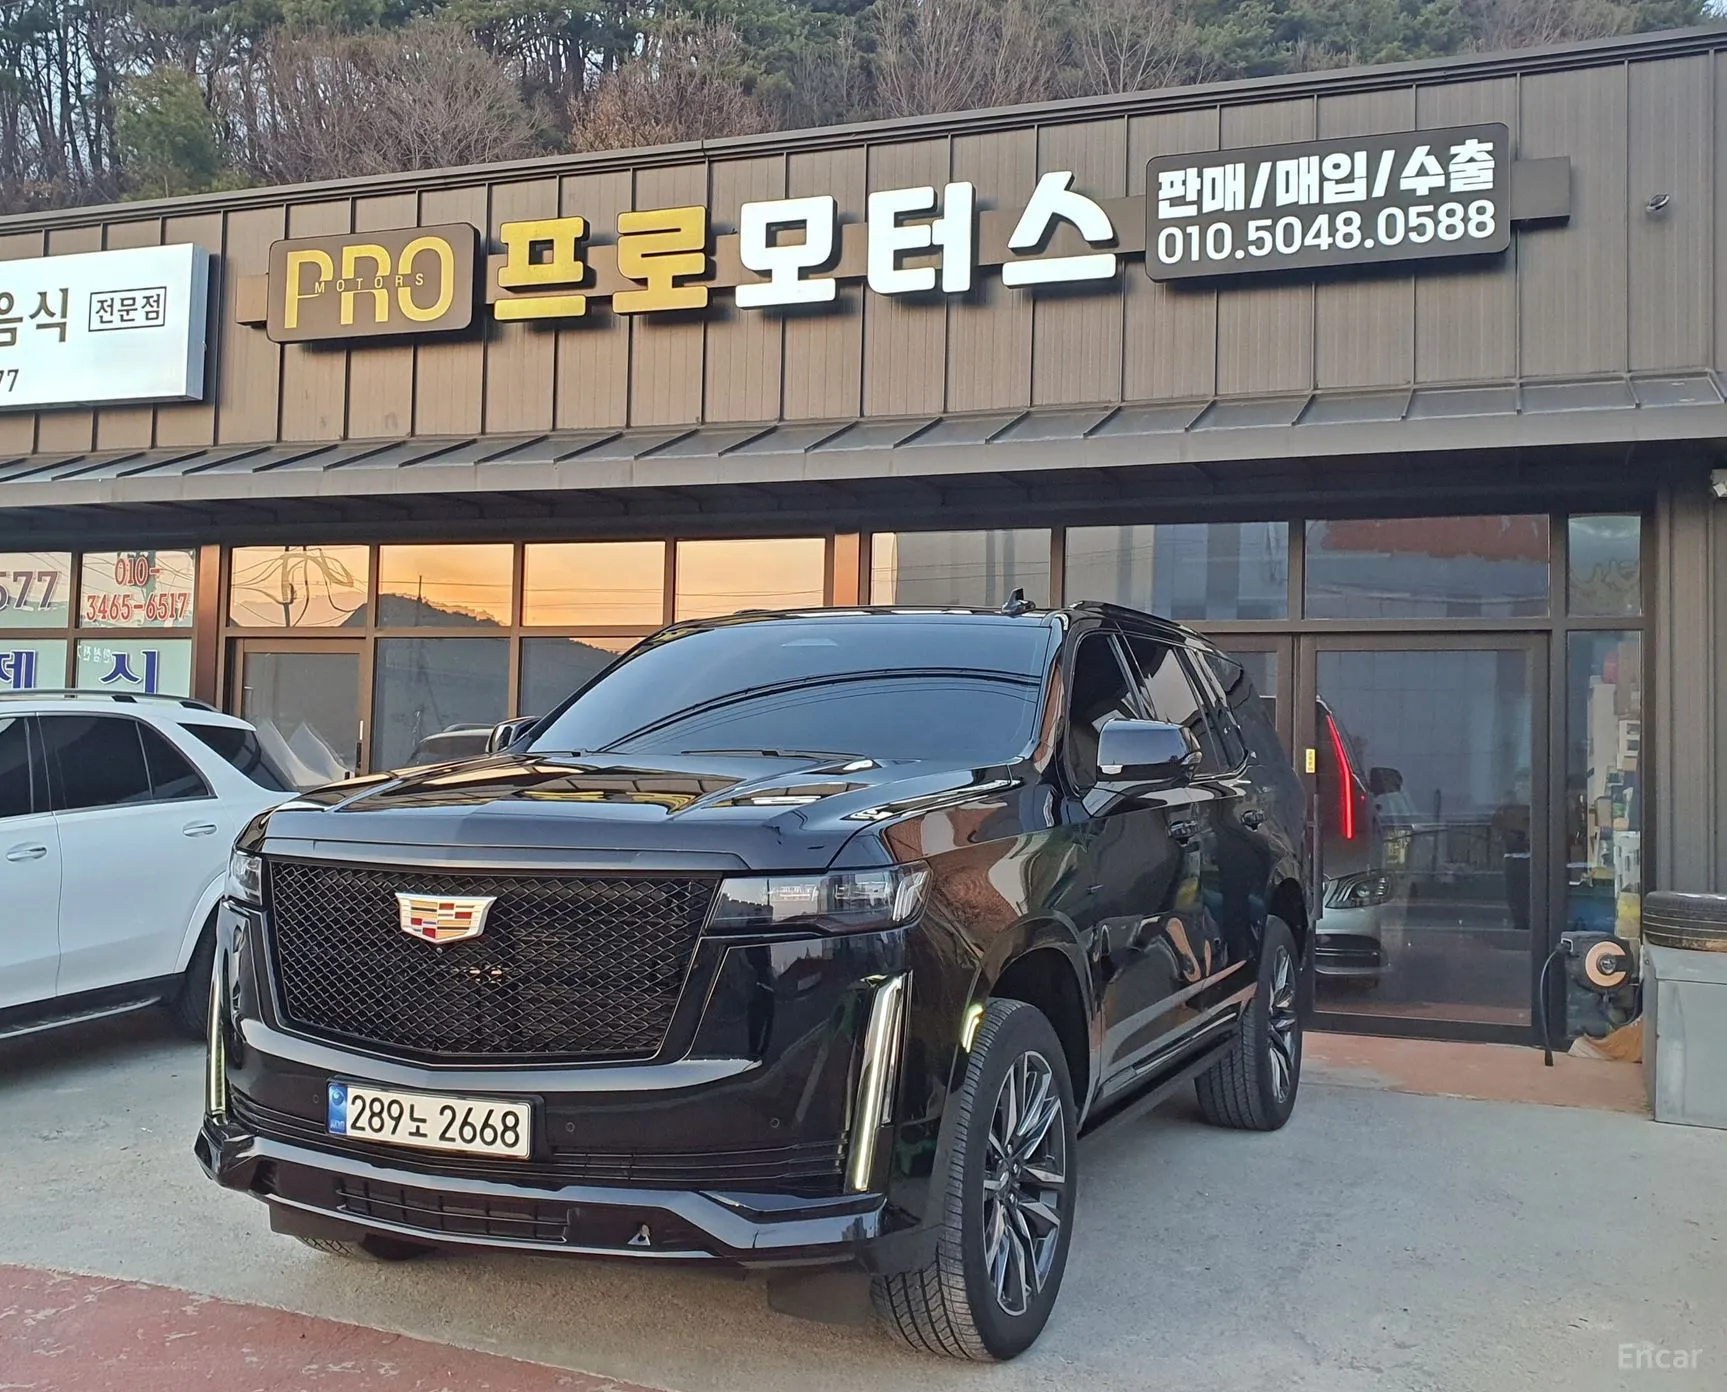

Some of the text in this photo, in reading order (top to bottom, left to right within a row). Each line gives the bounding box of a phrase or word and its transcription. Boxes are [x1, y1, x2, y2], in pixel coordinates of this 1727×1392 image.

[1158, 138, 1496, 219] 판매/매입/수출
[494, 170, 1117, 320] 프로모터스
[1157, 199, 1496, 265] 010.5048.0588
[95, 293, 162, 324] 전문점
[284, 236, 455, 329] PRO
[314, 273, 424, 294] MOTORS
[86, 592, 188, 622] 3465-6517
[350, 1094, 520, 1148] 289노 2668
